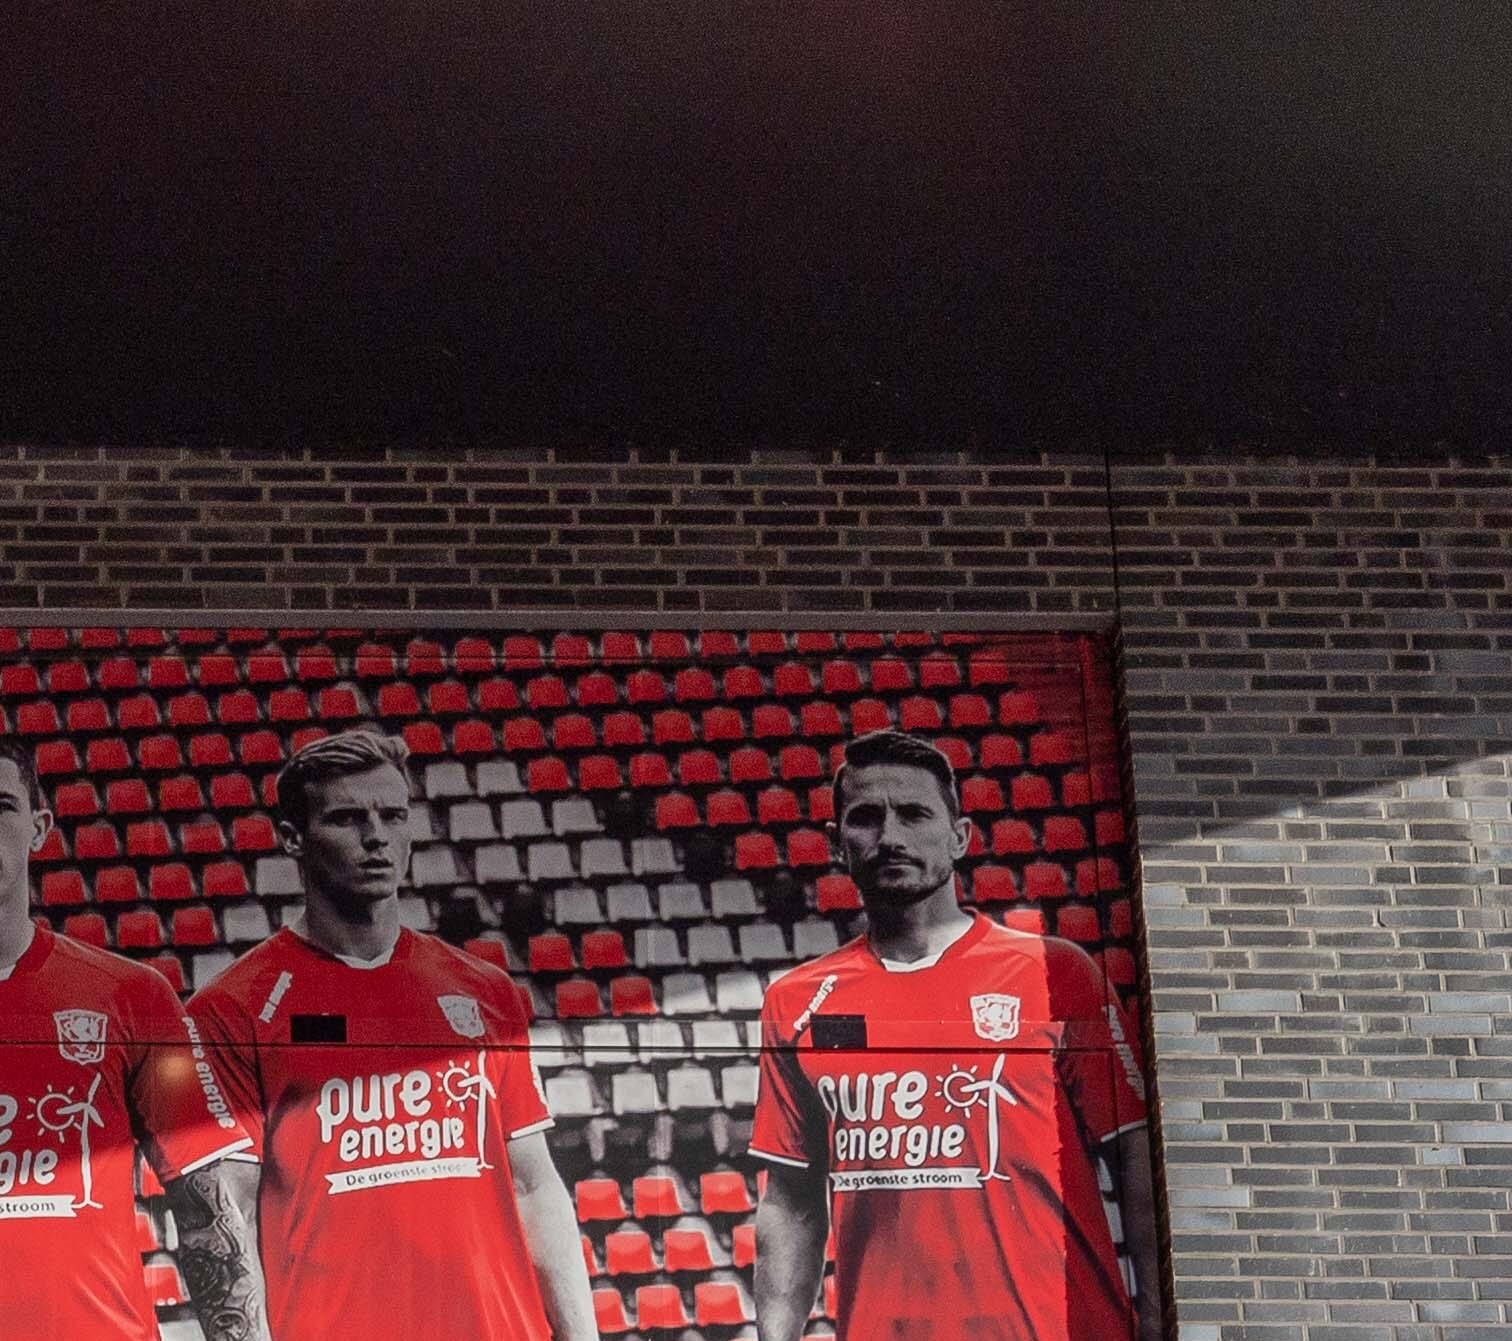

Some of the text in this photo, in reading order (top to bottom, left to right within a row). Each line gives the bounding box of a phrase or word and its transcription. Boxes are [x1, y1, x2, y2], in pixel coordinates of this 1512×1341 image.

[316, 1070, 433, 1144] pure
[339, 1118, 464, 1162] energie
[835, 1125, 966, 1167] energie
[346, 1174, 366, 1186] De
[911, 1172, 963, 1185] stroom
